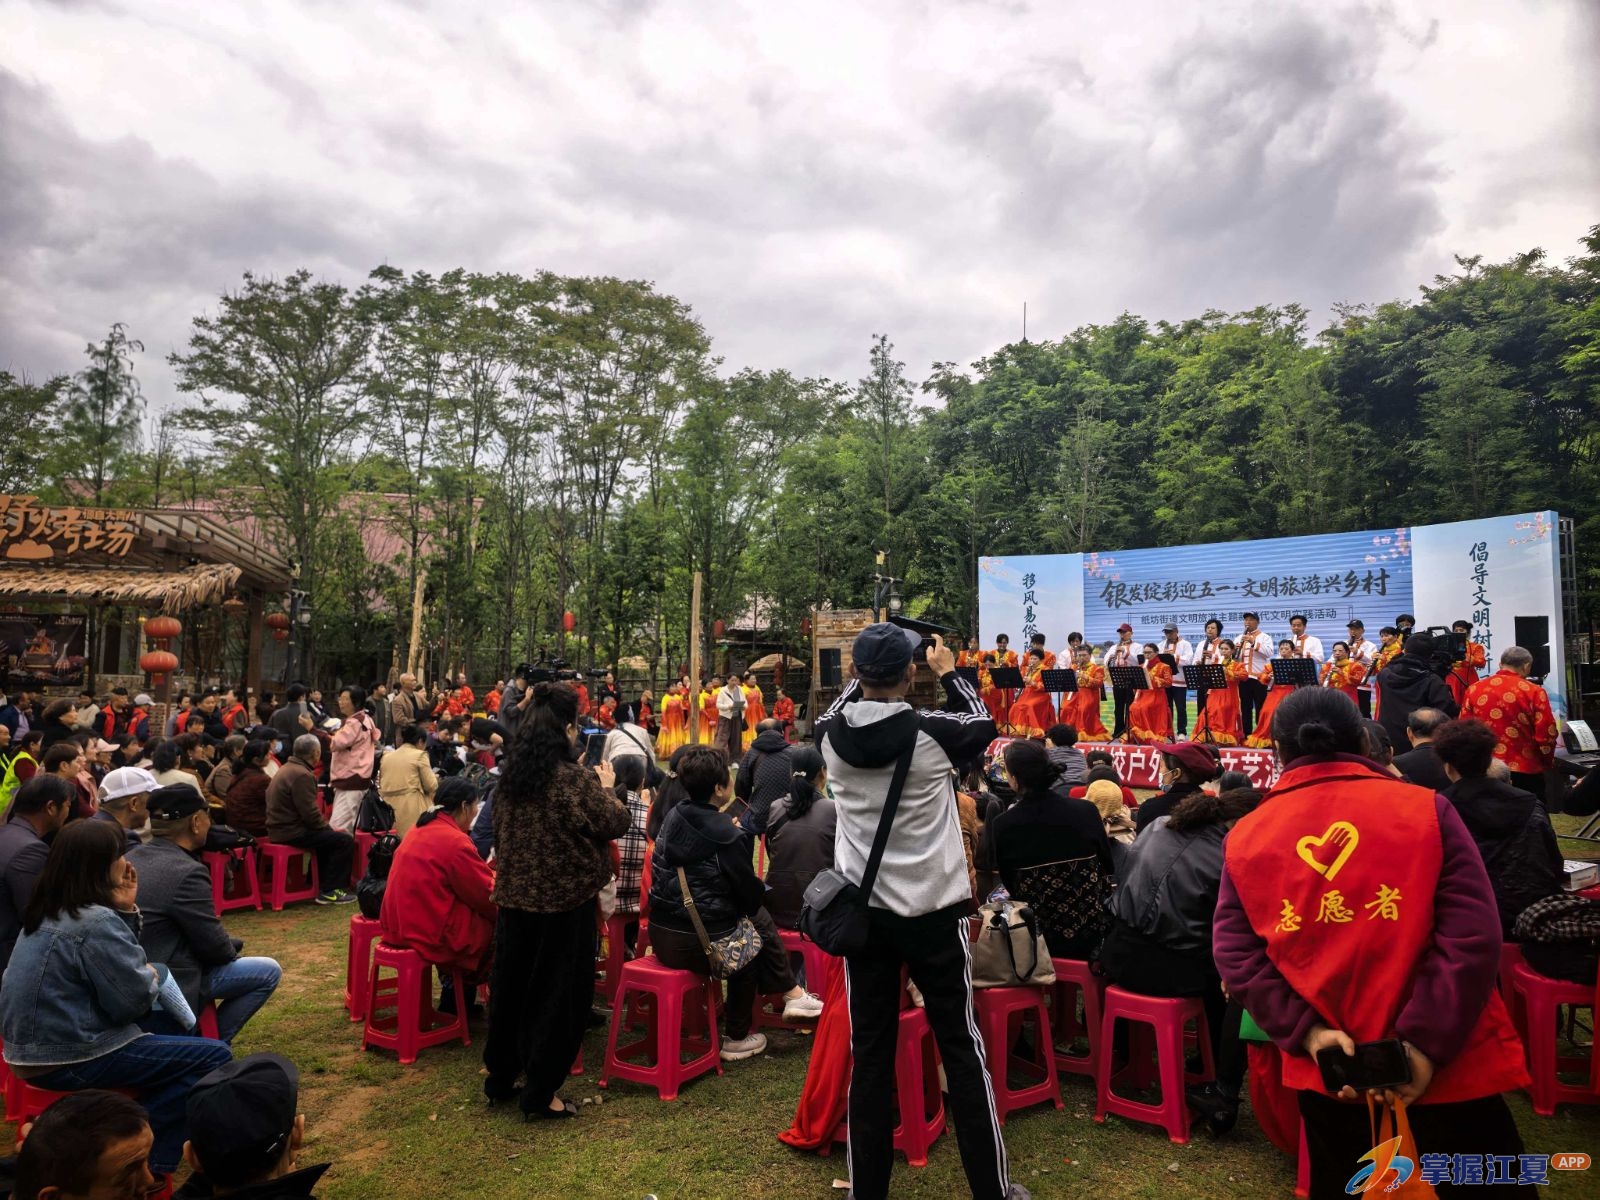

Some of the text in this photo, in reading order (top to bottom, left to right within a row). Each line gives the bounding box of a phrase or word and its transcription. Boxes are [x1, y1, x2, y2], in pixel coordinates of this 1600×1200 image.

[1469, 541, 1493, 680] 倡导文明树
[1275, 884, 1402, 933] 志愿者
